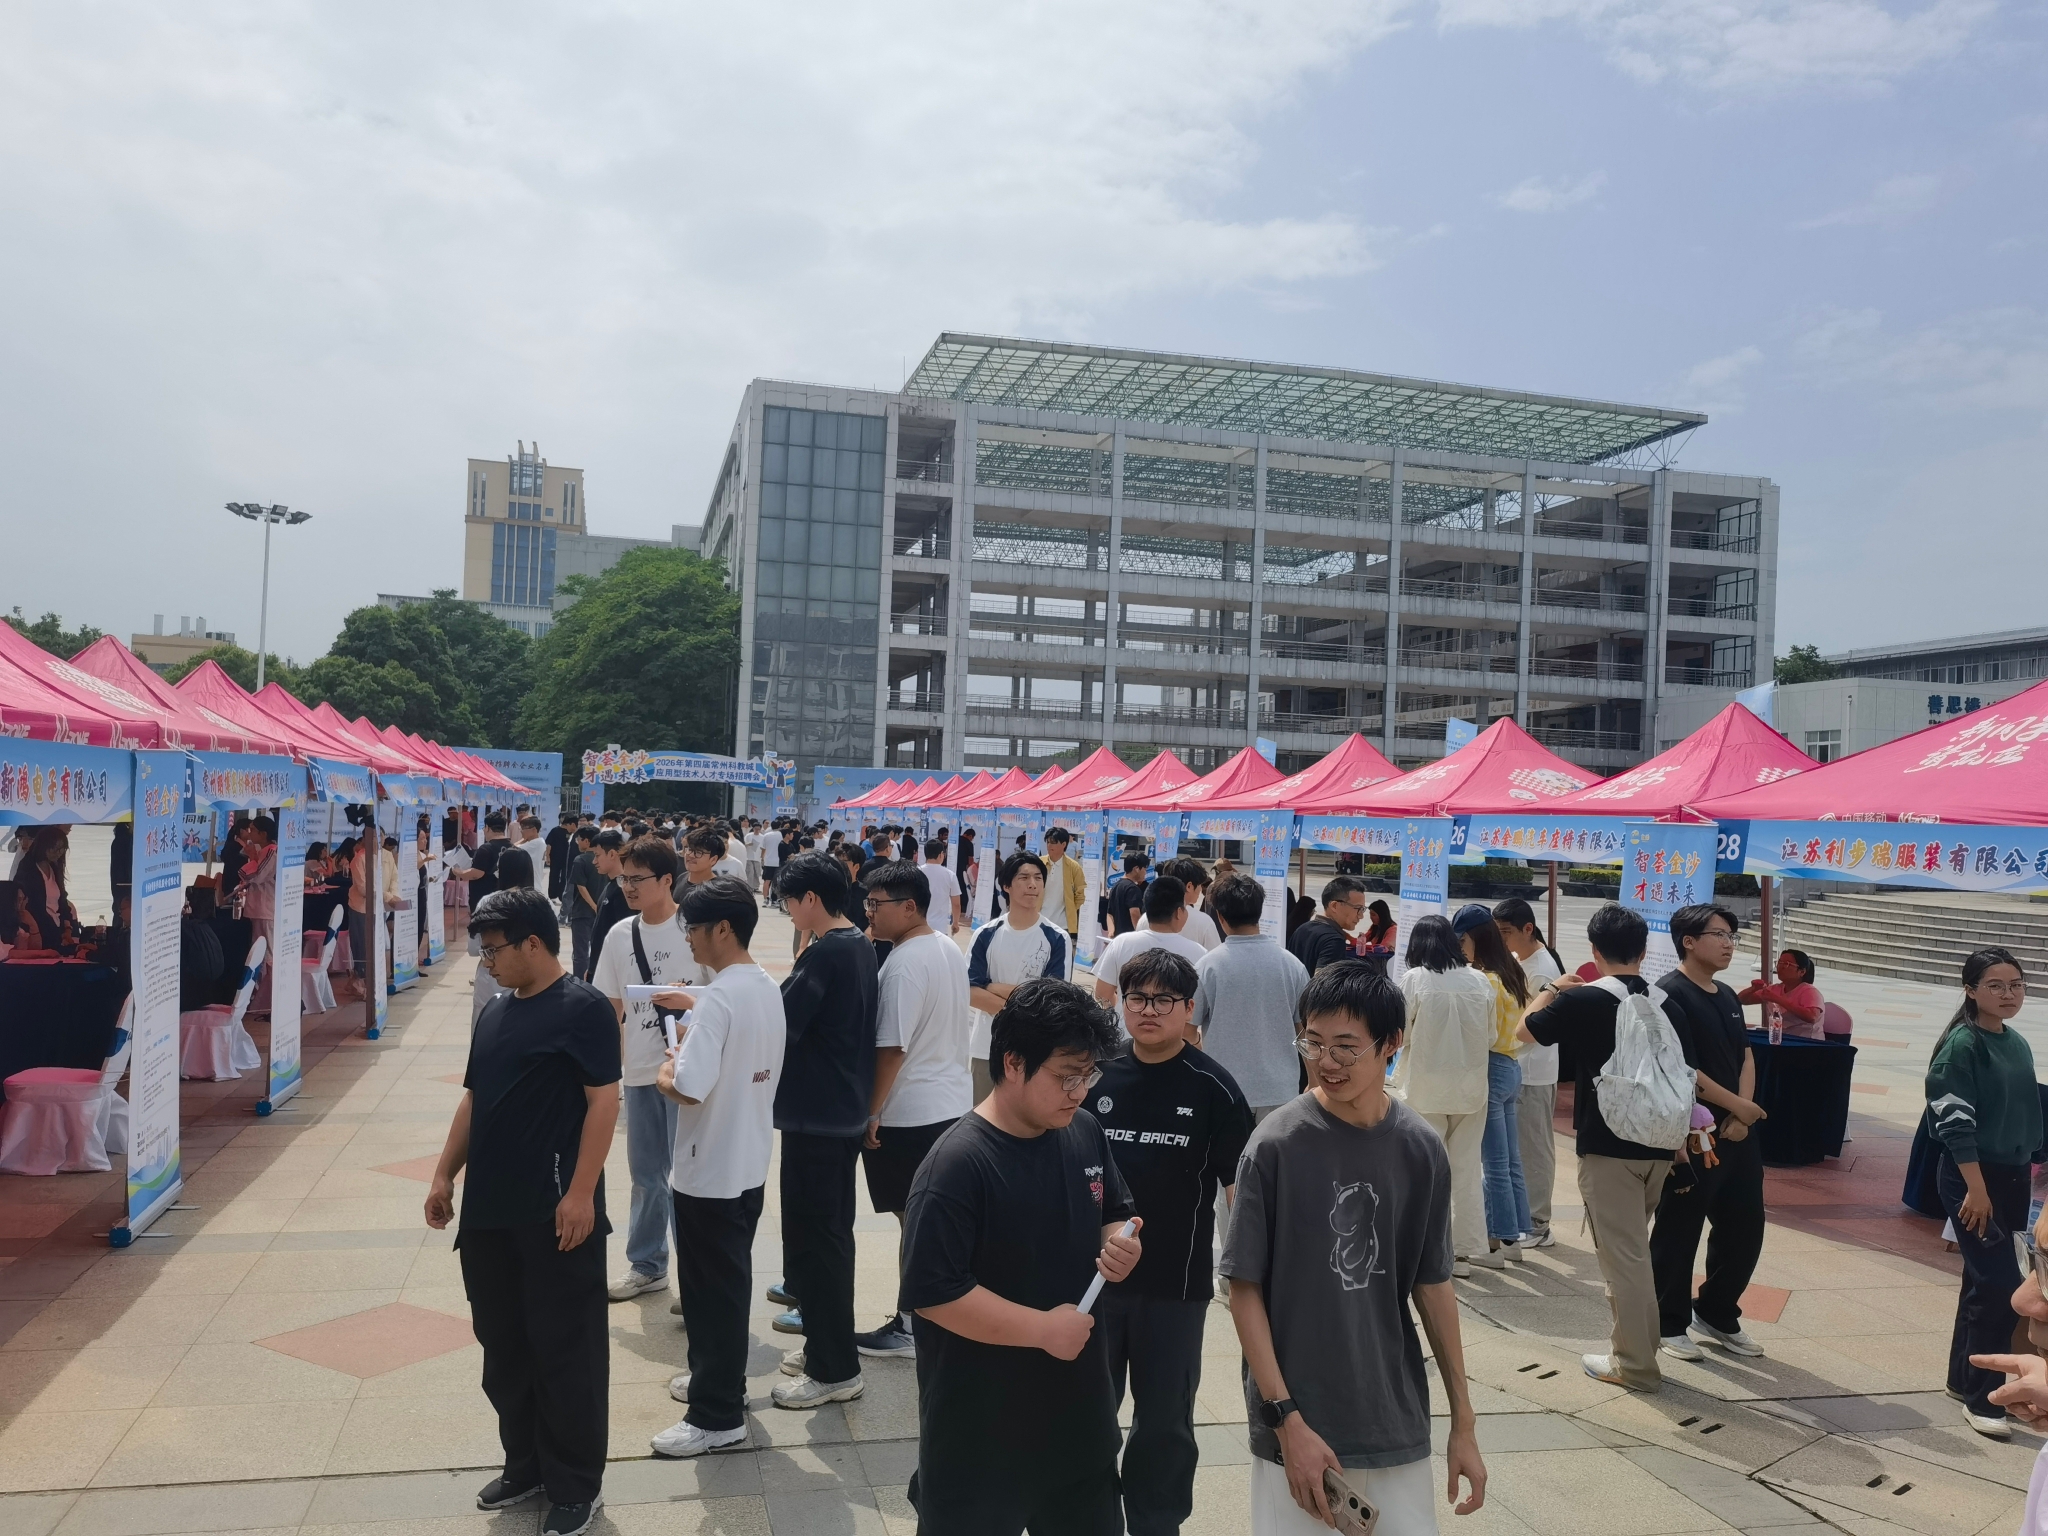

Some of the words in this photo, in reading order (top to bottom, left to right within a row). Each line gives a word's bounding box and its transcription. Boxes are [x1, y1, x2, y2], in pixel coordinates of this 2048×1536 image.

[583, 750, 648, 767] 智荟金沙
[655, 758, 754, 771] 2026年第四届常州科教城
[583, 767, 648, 783] 才遇未来
[655, 769, 761, 782] 应用型技术人才专场招聘会
[1181, 818, 1190, 832] 22
[1451, 825, 1466, 846] 26
[1717, 833, 1741, 860] 28
[1634, 849, 1701, 878] 智荟金沙
[1632, 879, 1696, 907] 才遇未来
[1103, 1128, 1137, 1142] ADE
[1139, 1131, 1190, 1147] BAICAI
